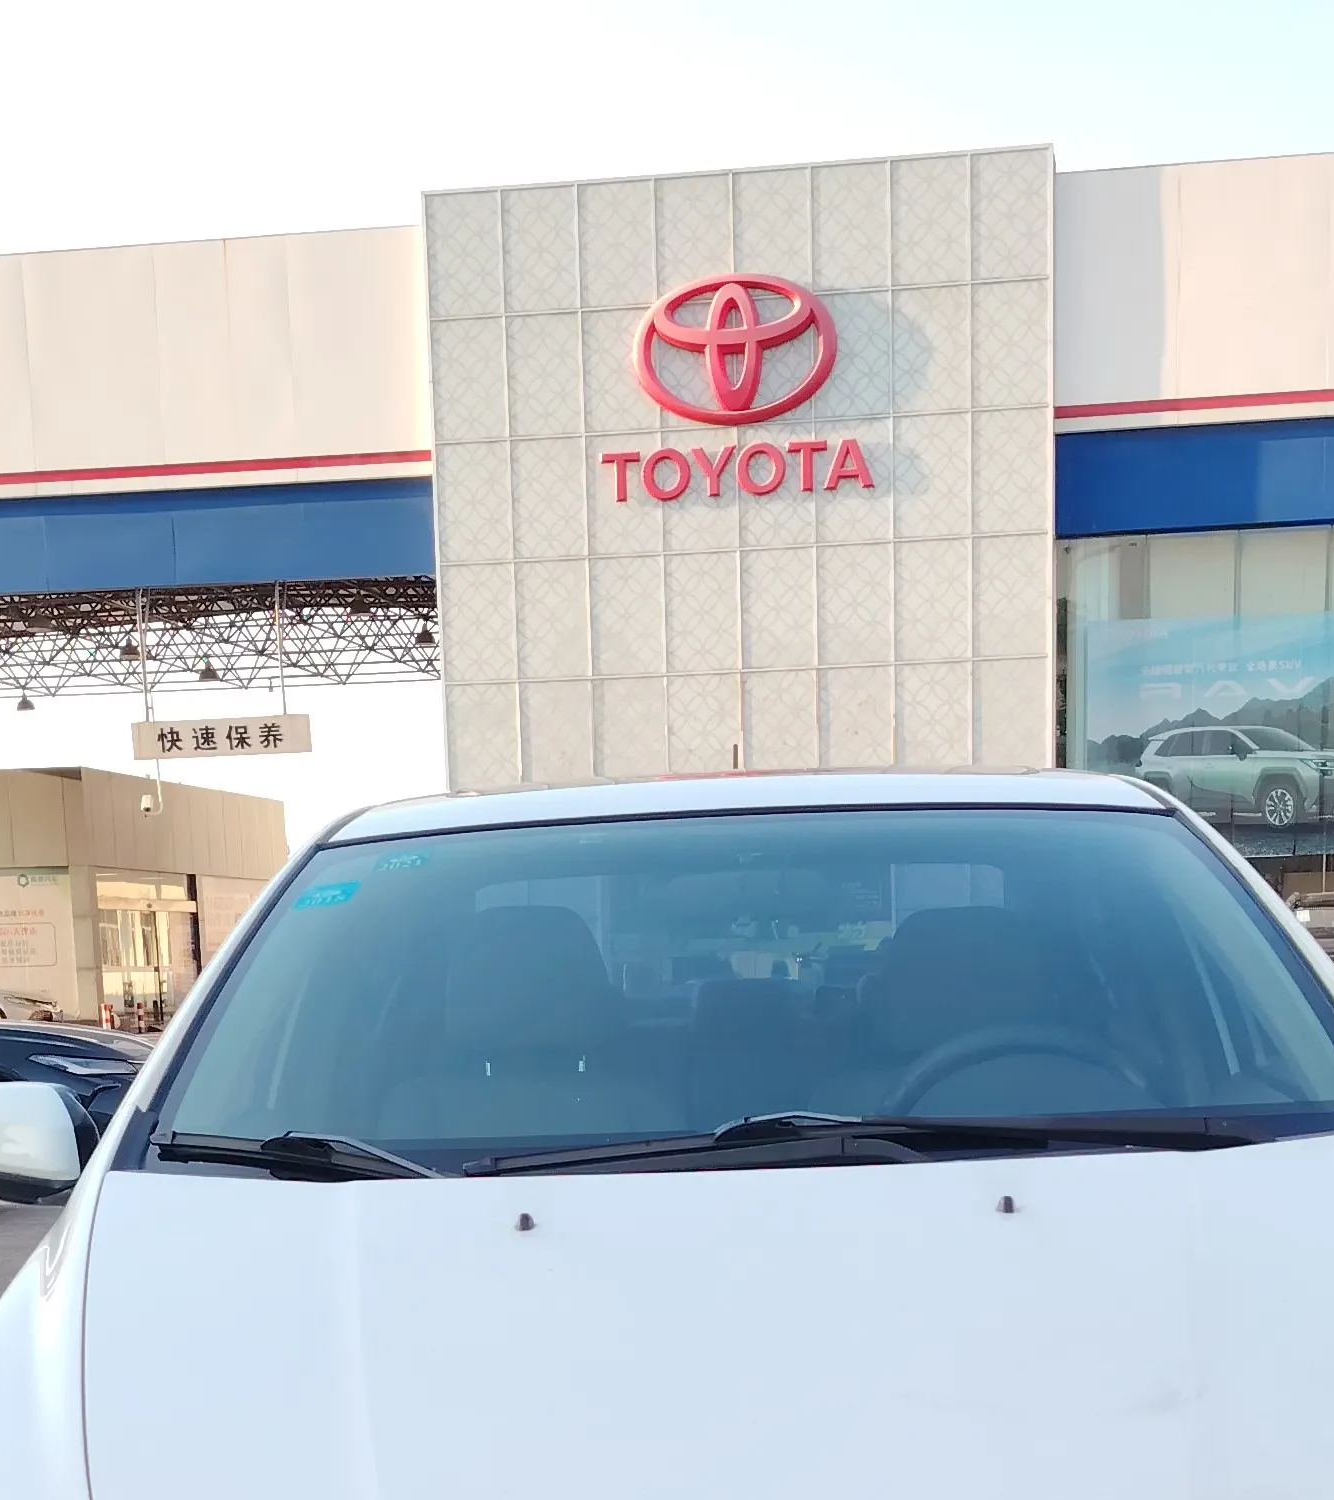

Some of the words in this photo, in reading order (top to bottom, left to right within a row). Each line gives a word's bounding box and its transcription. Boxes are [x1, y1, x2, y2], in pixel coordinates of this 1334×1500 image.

[598, 437, 875, 504] TOYOTA
[157, 722, 285, 752] 快速保养
